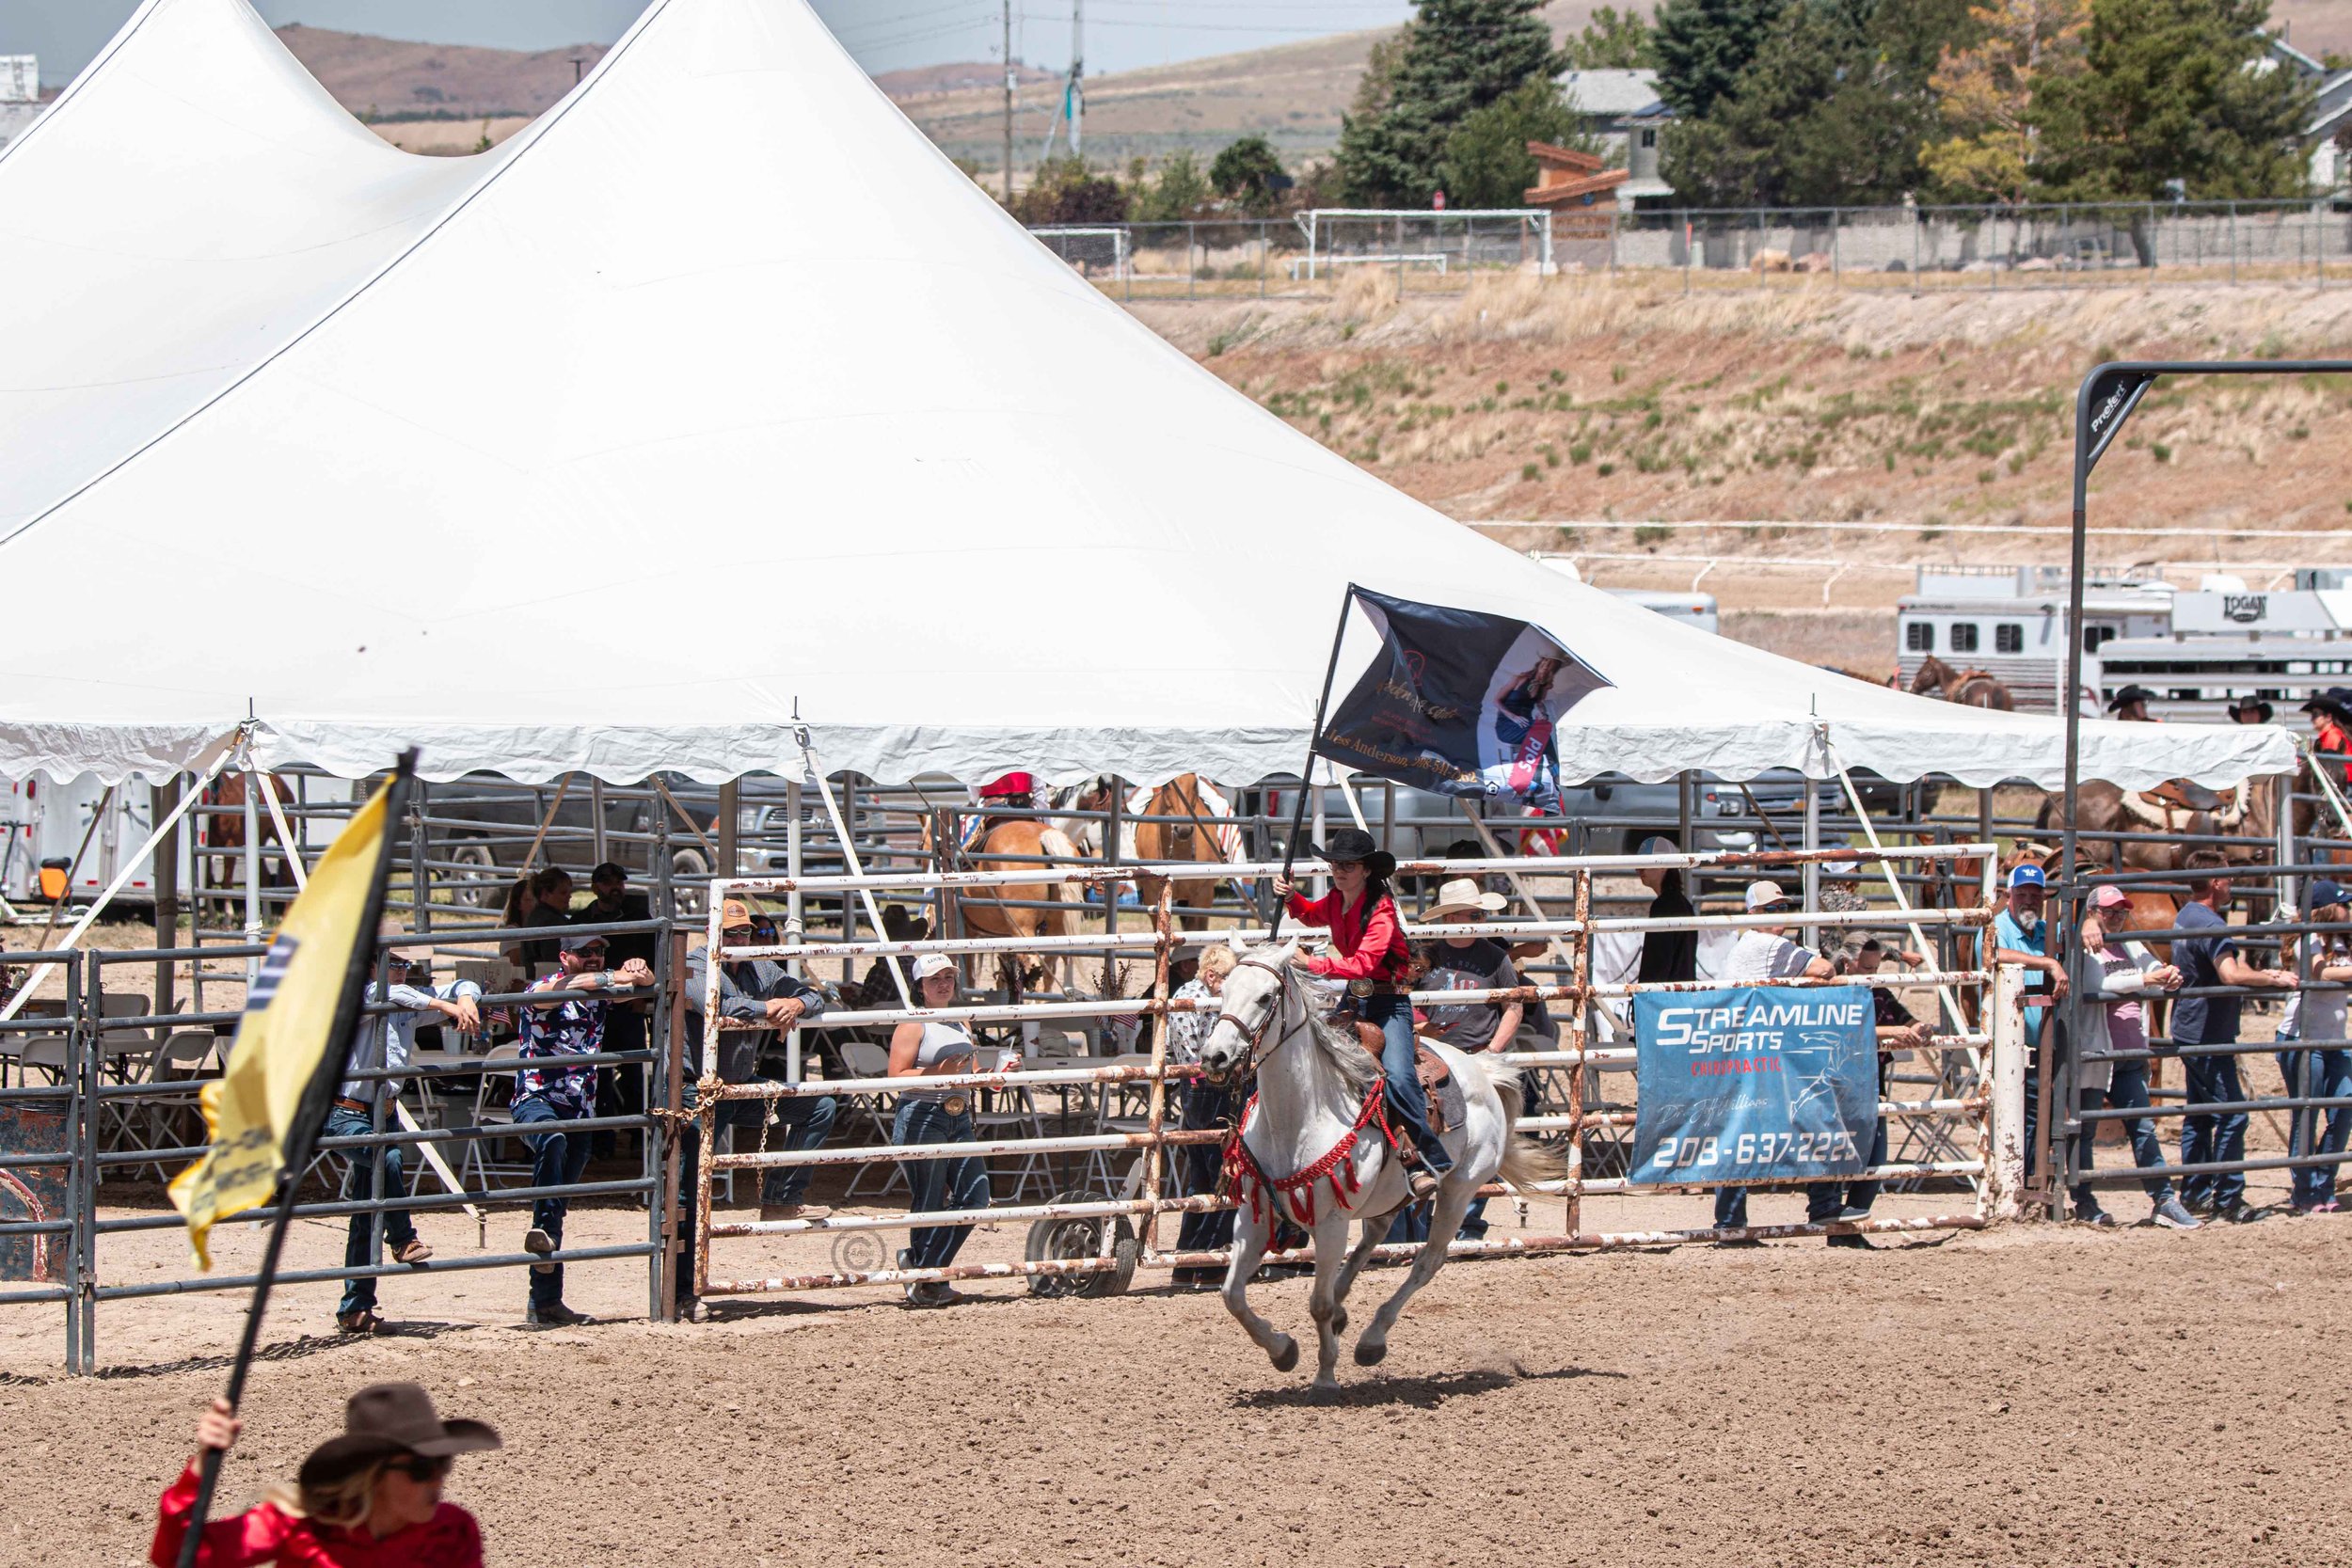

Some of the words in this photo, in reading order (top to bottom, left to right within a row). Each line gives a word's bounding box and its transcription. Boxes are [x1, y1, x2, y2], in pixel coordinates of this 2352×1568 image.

[2223, 595, 2267, 619] LOGAN
[1518, 736, 1543, 773] Sold
[1656, 1004, 1864, 1046] STREAMLINE
[1689, 1031, 1785, 1054] SPORTS
